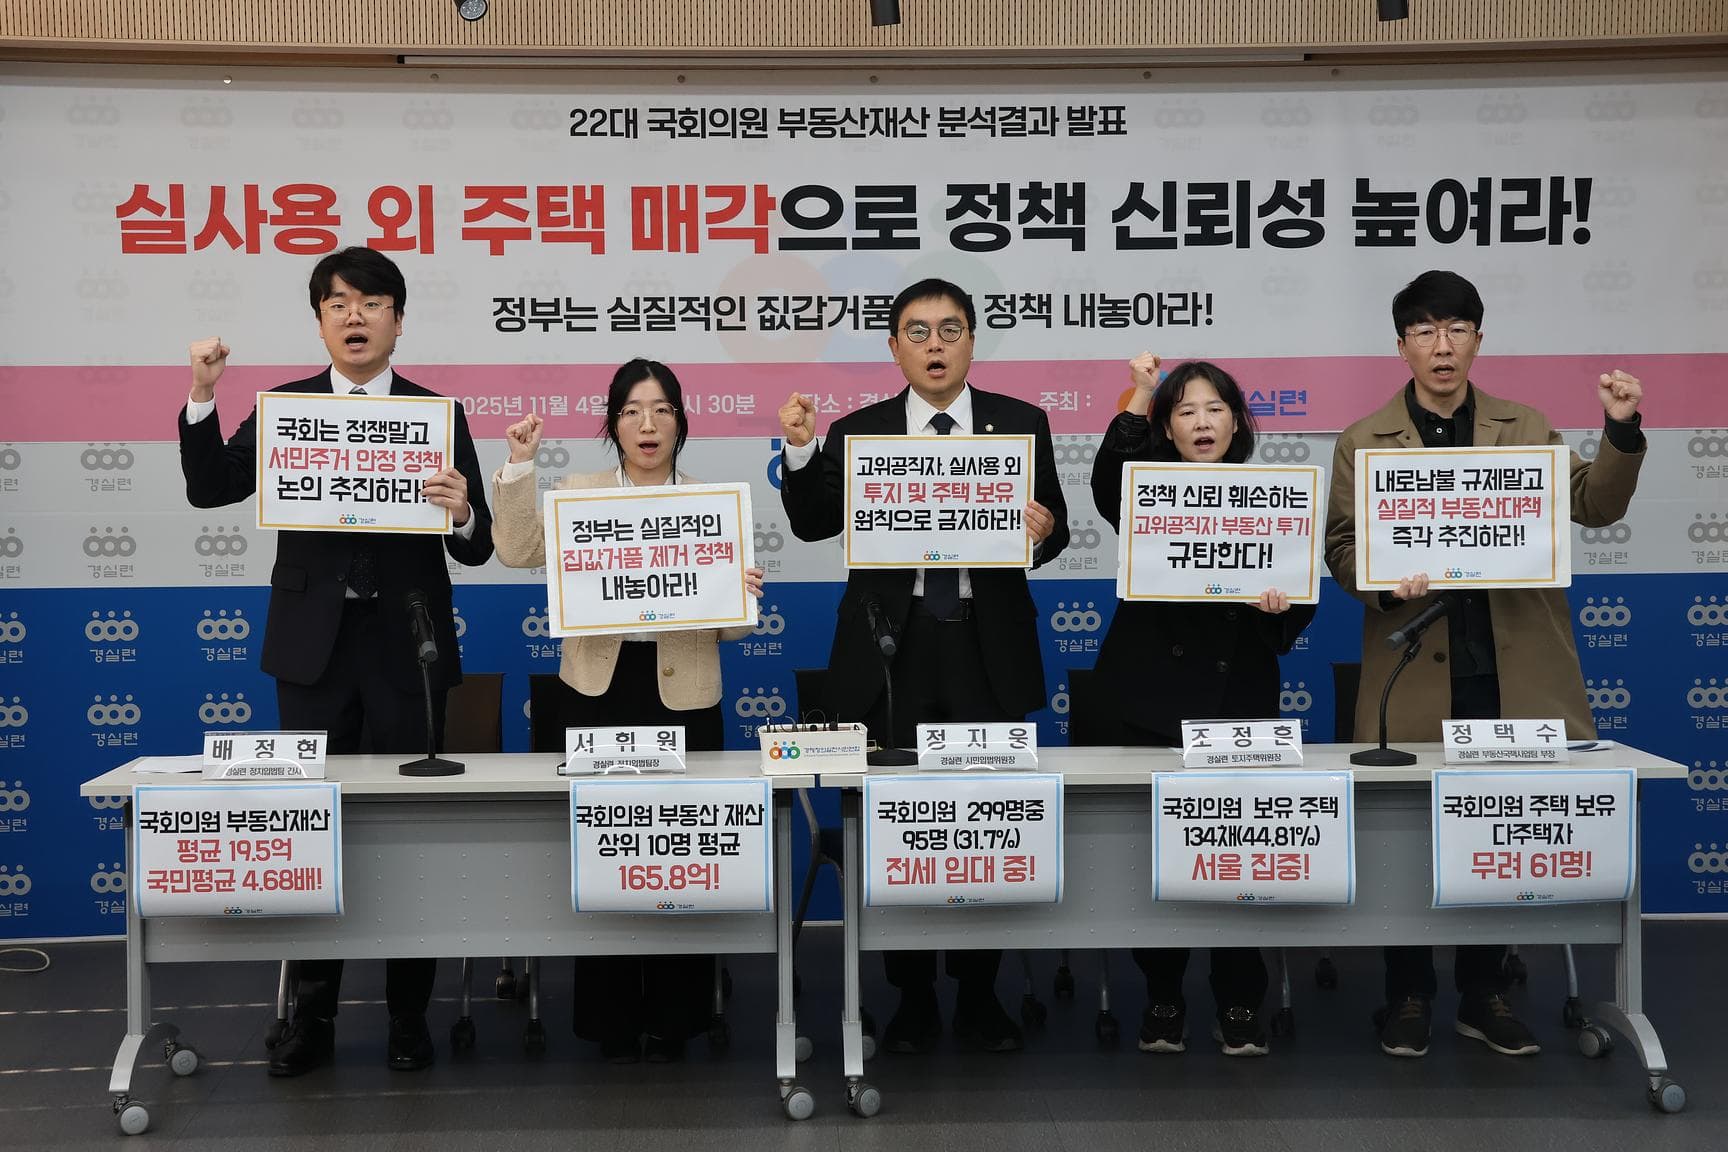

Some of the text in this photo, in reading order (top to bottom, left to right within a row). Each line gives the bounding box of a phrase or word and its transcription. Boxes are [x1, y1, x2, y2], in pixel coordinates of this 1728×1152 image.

[569, 105, 1128, 139] 22대 국회의원 부동산재산 분석결과 발표
[116, 176, 1593, 256] 실사용 외 주택 매각으로 정책 신뢰성 높여라!
[492, 297, 599, 332] 정부는
[607, 296, 746, 331] 실질적인
[984, 293, 1051, 329] 정책
[1063, 292, 1213, 328] 내놓아라!
[456, 396, 522, 416] 025년
[529, 396, 568, 416] 11월
[708, 395, 755, 415] 30분
[1039, 391, 1078, 412] 주최
[1241, 390, 1307, 416] 실련
[277, 417, 430, 445] 국회는 정쟁말고
[268, 447, 443, 473] 서민주거 안정 정책
[950, 456, 1000, 476] 실사용
[1004, 456, 1021, 476] 외
[85, 478, 131, 491] 경실련
[277, 475, 427, 504] 논의 추진하라!
[1375, 468, 1544, 493] 내로남불 규제말고
[908, 482, 926, 504] 및
[932, 482, 970, 504] 주택
[975, 482, 1014, 504] 보유
[1137, 484, 1309, 509] 정책 신뢰 훼손하는
[1376, 496, 1542, 520] 실질적 부동산대책
[572, 513, 722, 544] 정부는 실질적인
[854, 508, 1021, 532] 원칙으로 금지하라!
[1133, 515, 1310, 536] 고위공직자 부동산 투기
[1392, 524, 1525, 548] 즉각 추진하라!
[563, 541, 734, 572] 집값거품 제거 정책
[754, 560, 781, 573] 실련
[1057, 557, 1098, 570] 경실련
[1167, 541, 1273, 569] 규탄한다!
[1584, 551, 1628, 565] 경실련
[88, 565, 134, 578] 경실련
[199, 563, 245, 577] 경실련
[602, 572, 698, 601] 내놓아라!
[738, 643, 782, 656] 경실련
[1055, 639, 1098, 652] 경실련
[1584, 634, 1628, 648] 경실련
[90, 649, 136, 662] 경실련
[201, 647, 247, 661] 경실련
[1594, 716, 1627, 729] 실련
[91, 732, 138, 746] 경실련
[941, 756, 962, 765] 경실련
[1207, 755, 1228, 764] 경실련
[576, 804, 764, 827] 국회의원 부동산 재산
[877, 800, 1044, 824] 국회의원 299명중
[1163, 797, 1338, 820] 국회의원 보유 주택
[1443, 794, 1616, 818] 국회의원 주택 보유
[0, 818, 27, 832] 실련
[93, 817, 124, 830] 경실
[139, 809, 330, 834] 국회의원 부동산재산
[597, 832, 741, 857] 상위 10명 평균
[902, 828, 1021, 850] 95명 (31.7%)
[1184, 825, 1321, 847] 134채(44.81%)
[1493, 823, 1573, 845] 다주택자
[177, 837, 292, 863] 평균 19.5억
[619, 863, 720, 891] 165.8억!
[886, 855, 1035, 885] 전세 임대 중!
[1192, 853, 1310, 881] 서울 집중!
[1472, 851, 1592, 880] 무려 61명!
[147, 867, 322, 893] 국민평균 4.68배!
[0, 902, 28, 916] 실련
[94, 900, 125, 914] 경실
